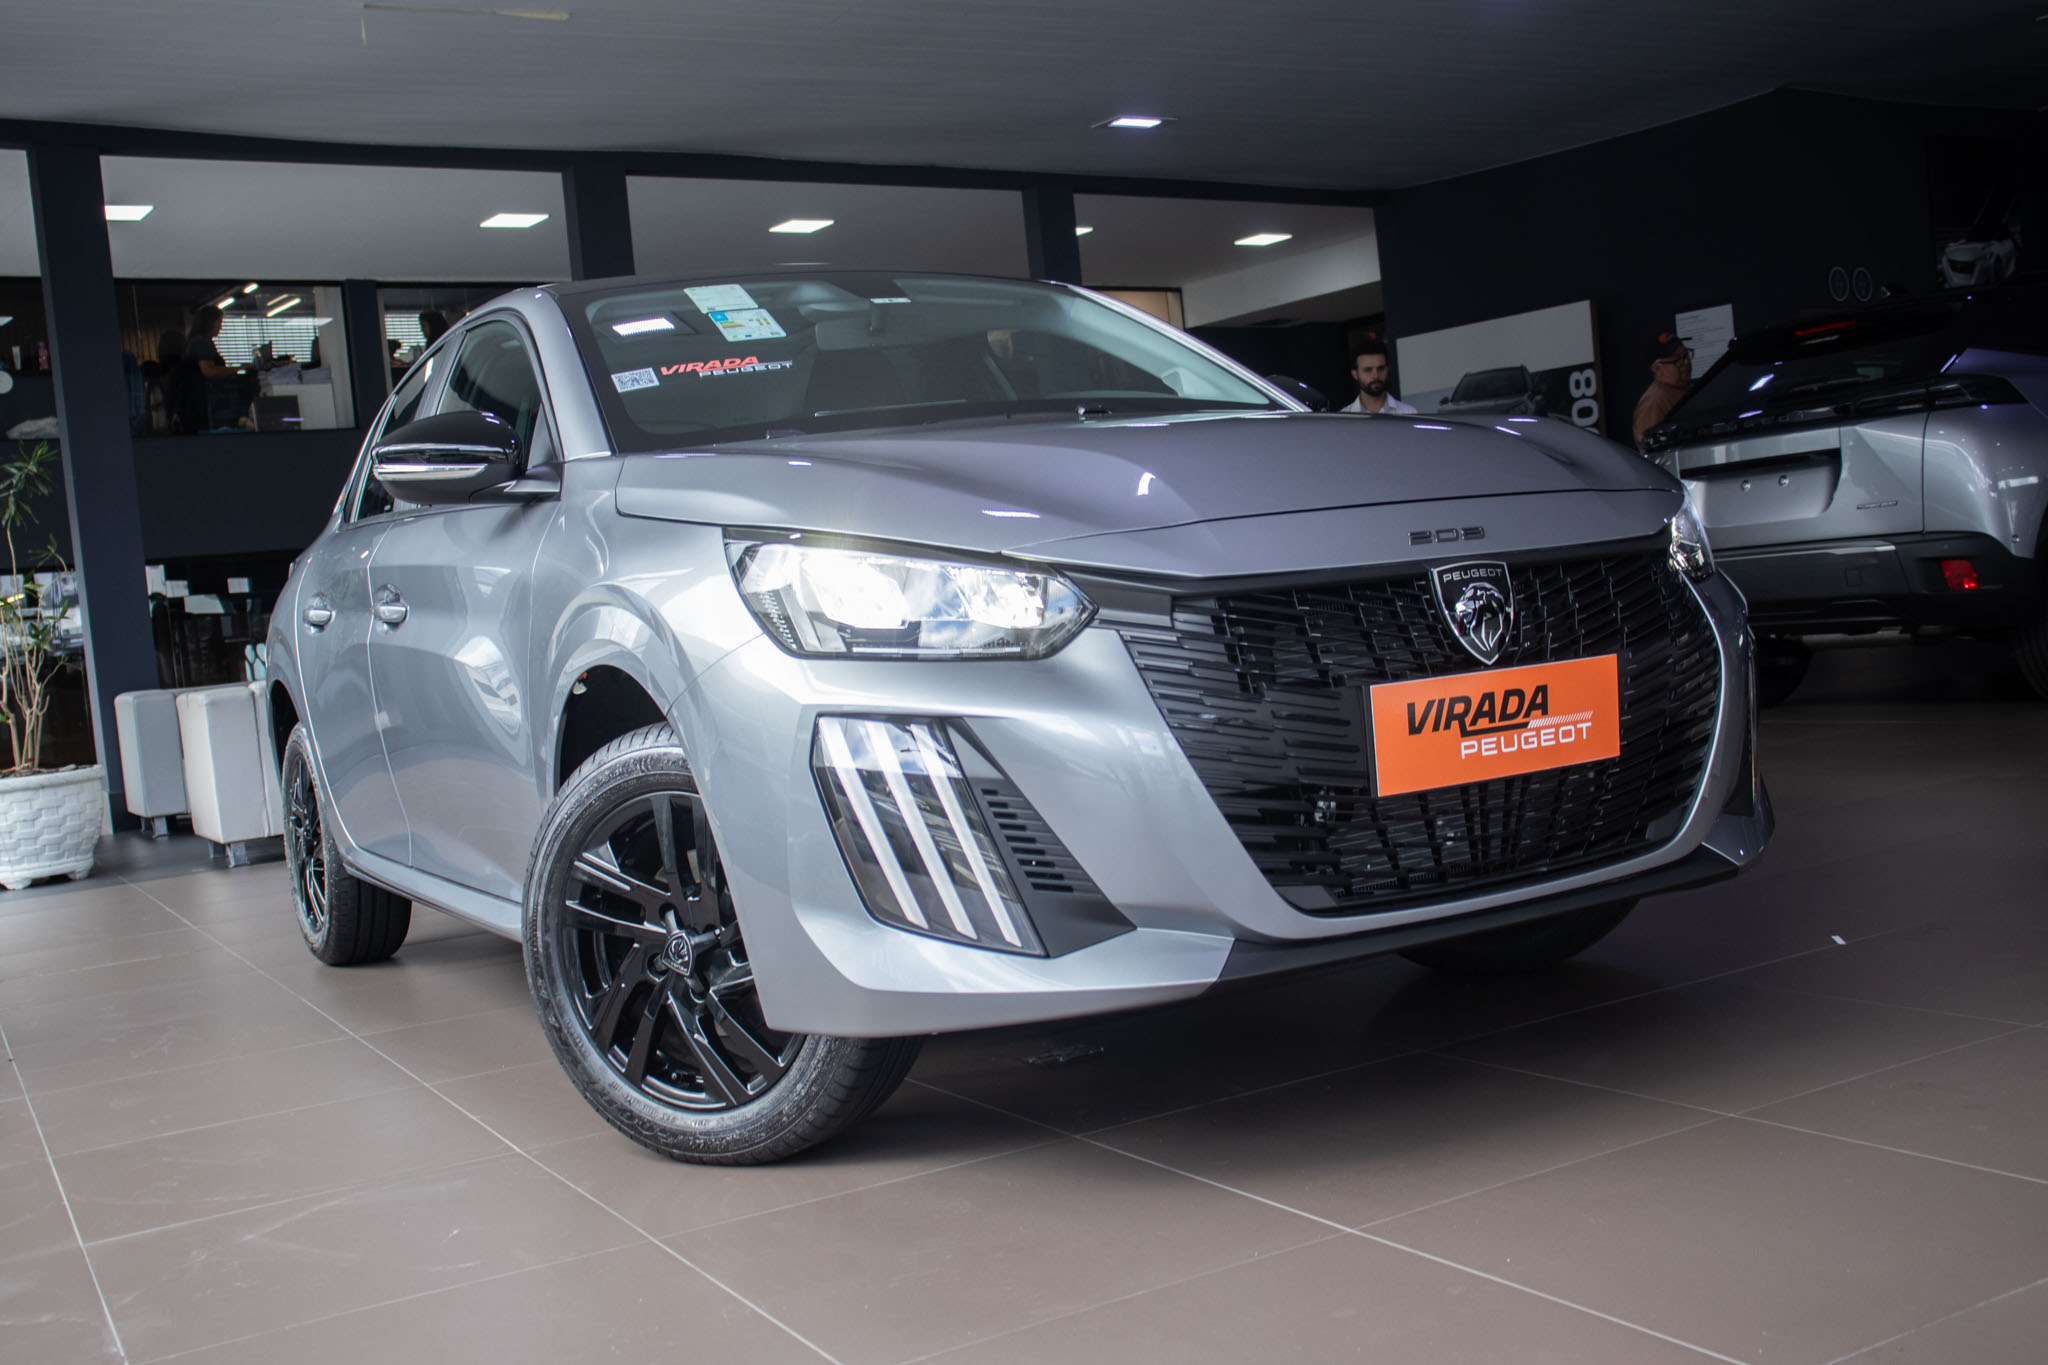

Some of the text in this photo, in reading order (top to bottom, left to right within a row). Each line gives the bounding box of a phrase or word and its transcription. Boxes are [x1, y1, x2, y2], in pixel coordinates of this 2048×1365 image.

[660, 356, 759, 376] VIRADA
[699, 362, 792, 377] PEUGEOT
[1569, 367, 1601, 436] 08
[1408, 525, 1485, 546] 208
[1442, 567, 1503, 584] PEUGEOT
[1406, 683, 1549, 738] VIRADA
[1461, 721, 1593, 760] PEUGEOT
